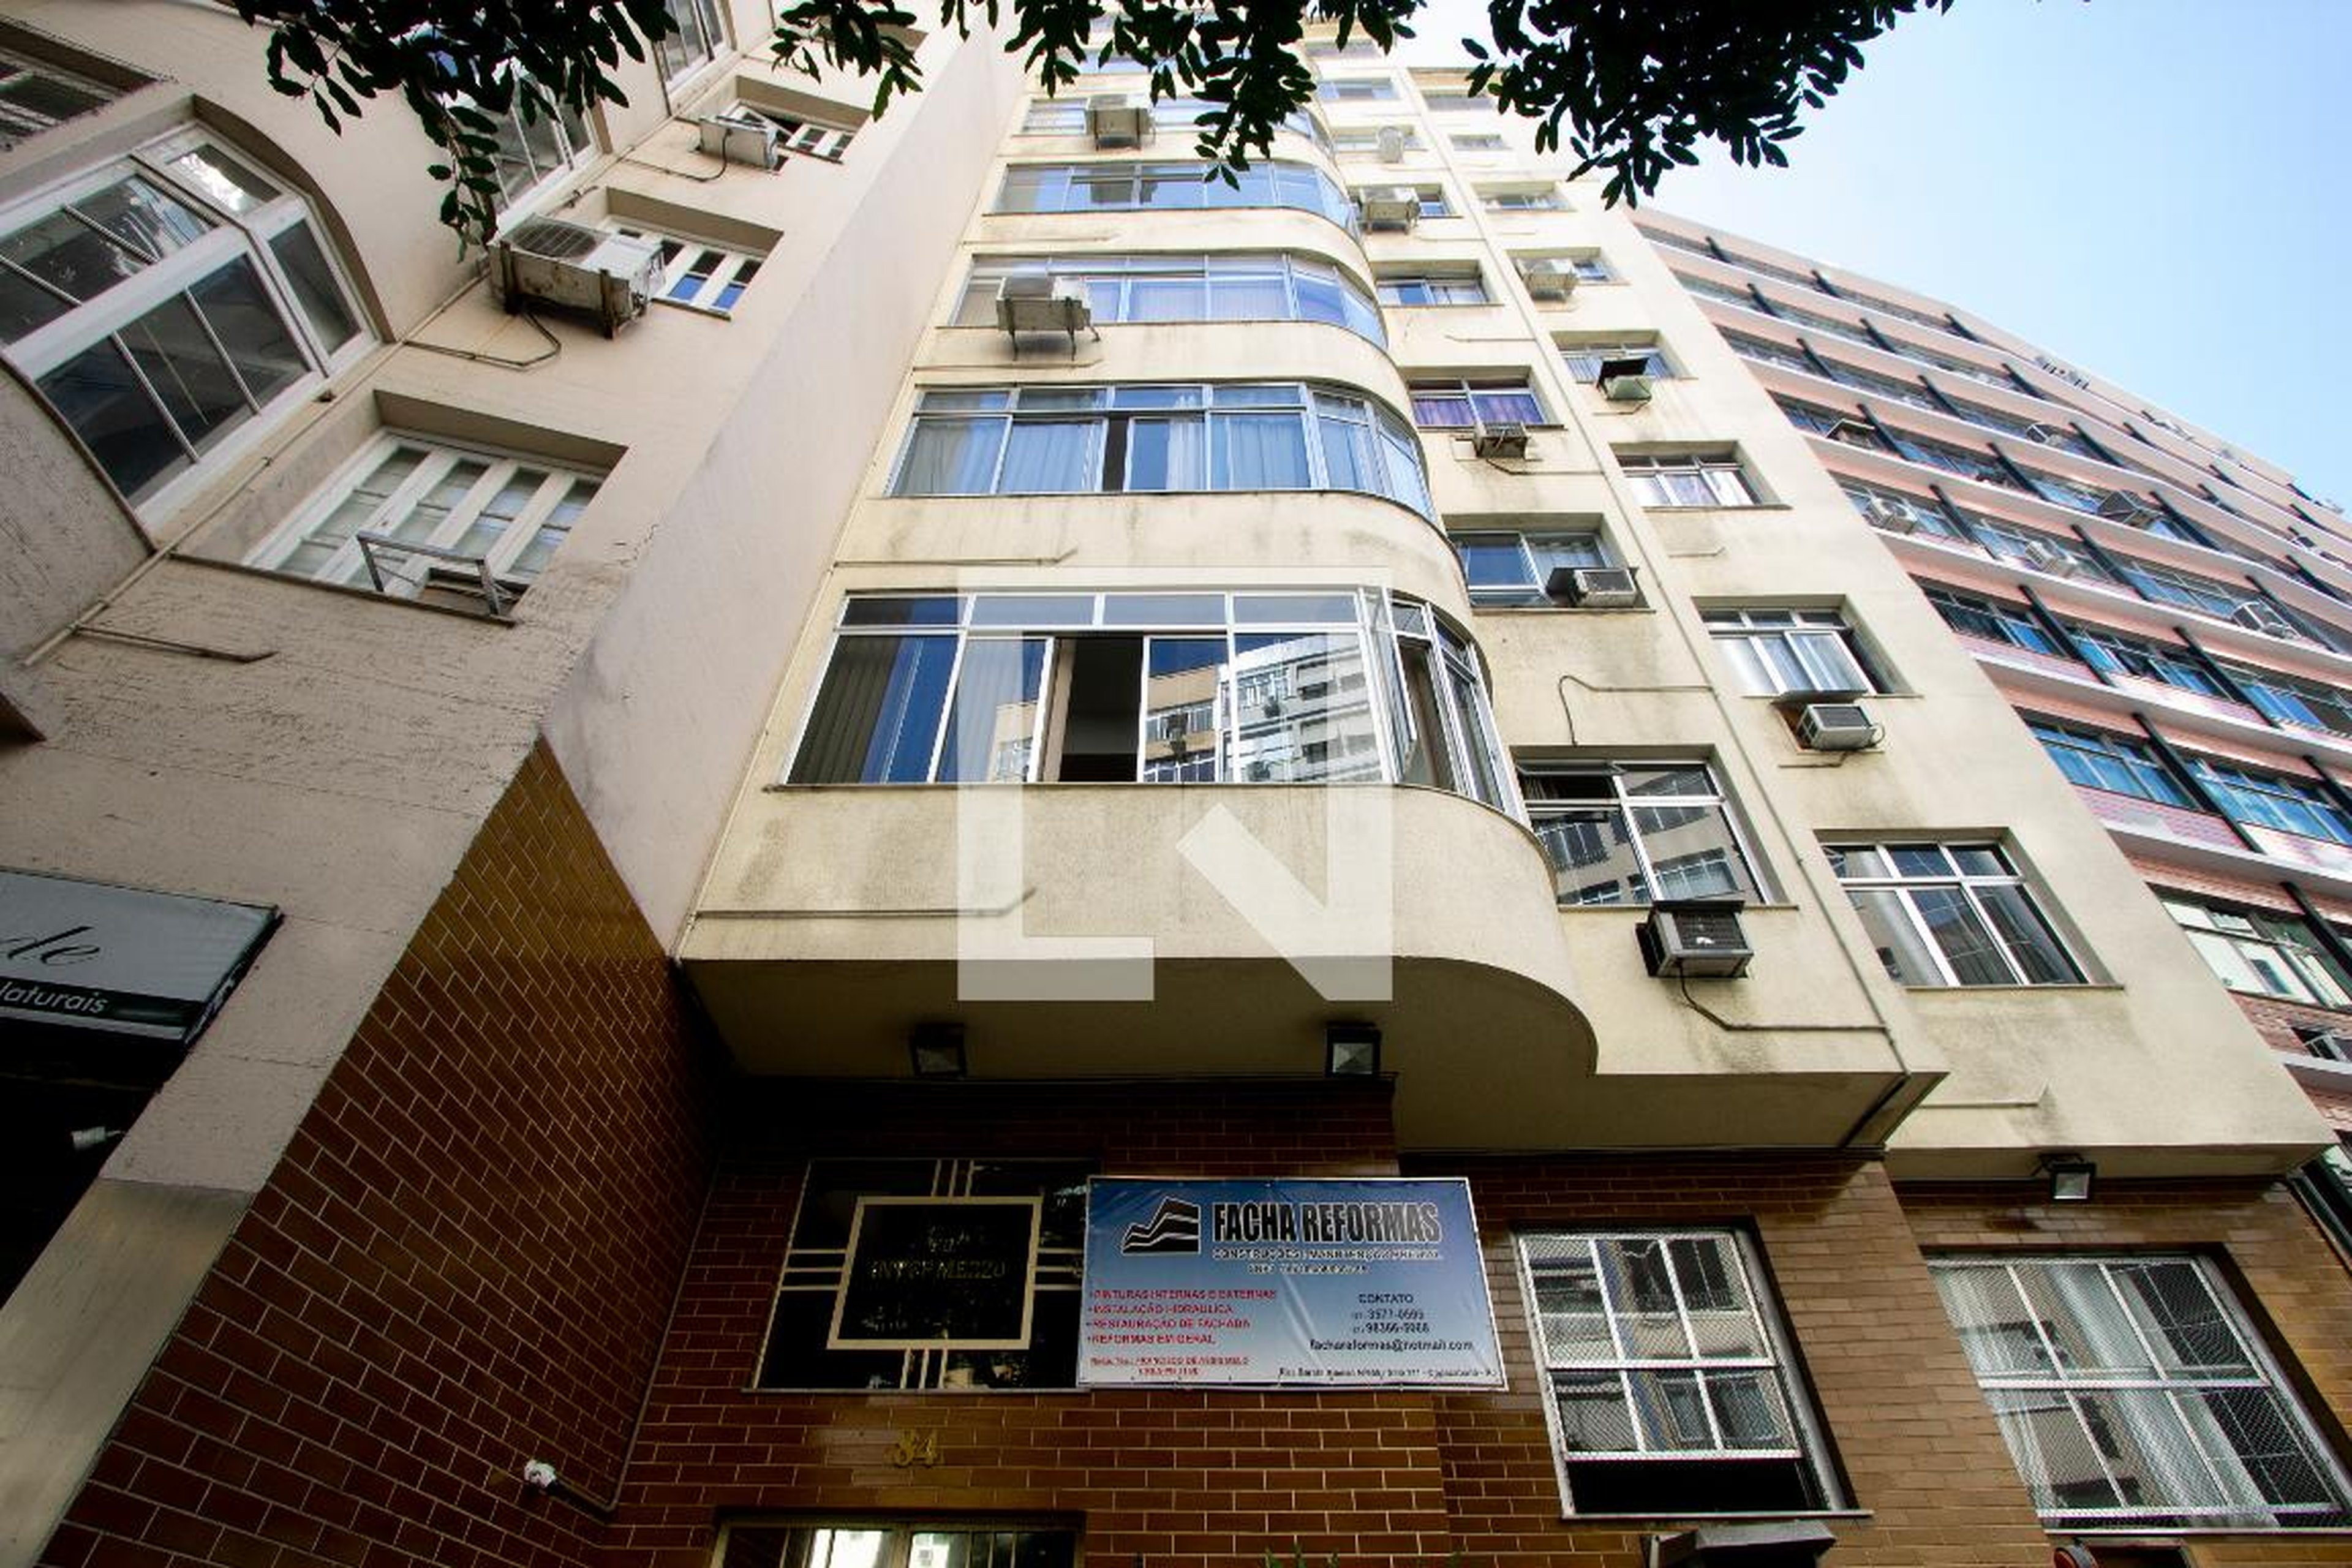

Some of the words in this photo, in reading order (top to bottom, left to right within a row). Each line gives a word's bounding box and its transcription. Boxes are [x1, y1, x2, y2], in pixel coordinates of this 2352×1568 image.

[1213, 1202, 1297, 1242] FACHA
[1302, 1202, 1442, 1243] REFORMAS
[1093, 1290, 1148, 1299] PINTURAS
[1359, 1294, 1414, 1303] CONTATO
[1180, 1319, 1192, 1328] DE
[1198, 1319, 1250, 1328] FACHADA
[1092, 1335, 1155, 1344] REFORMAS
[1177, 1335, 1216, 1344] GERAL
